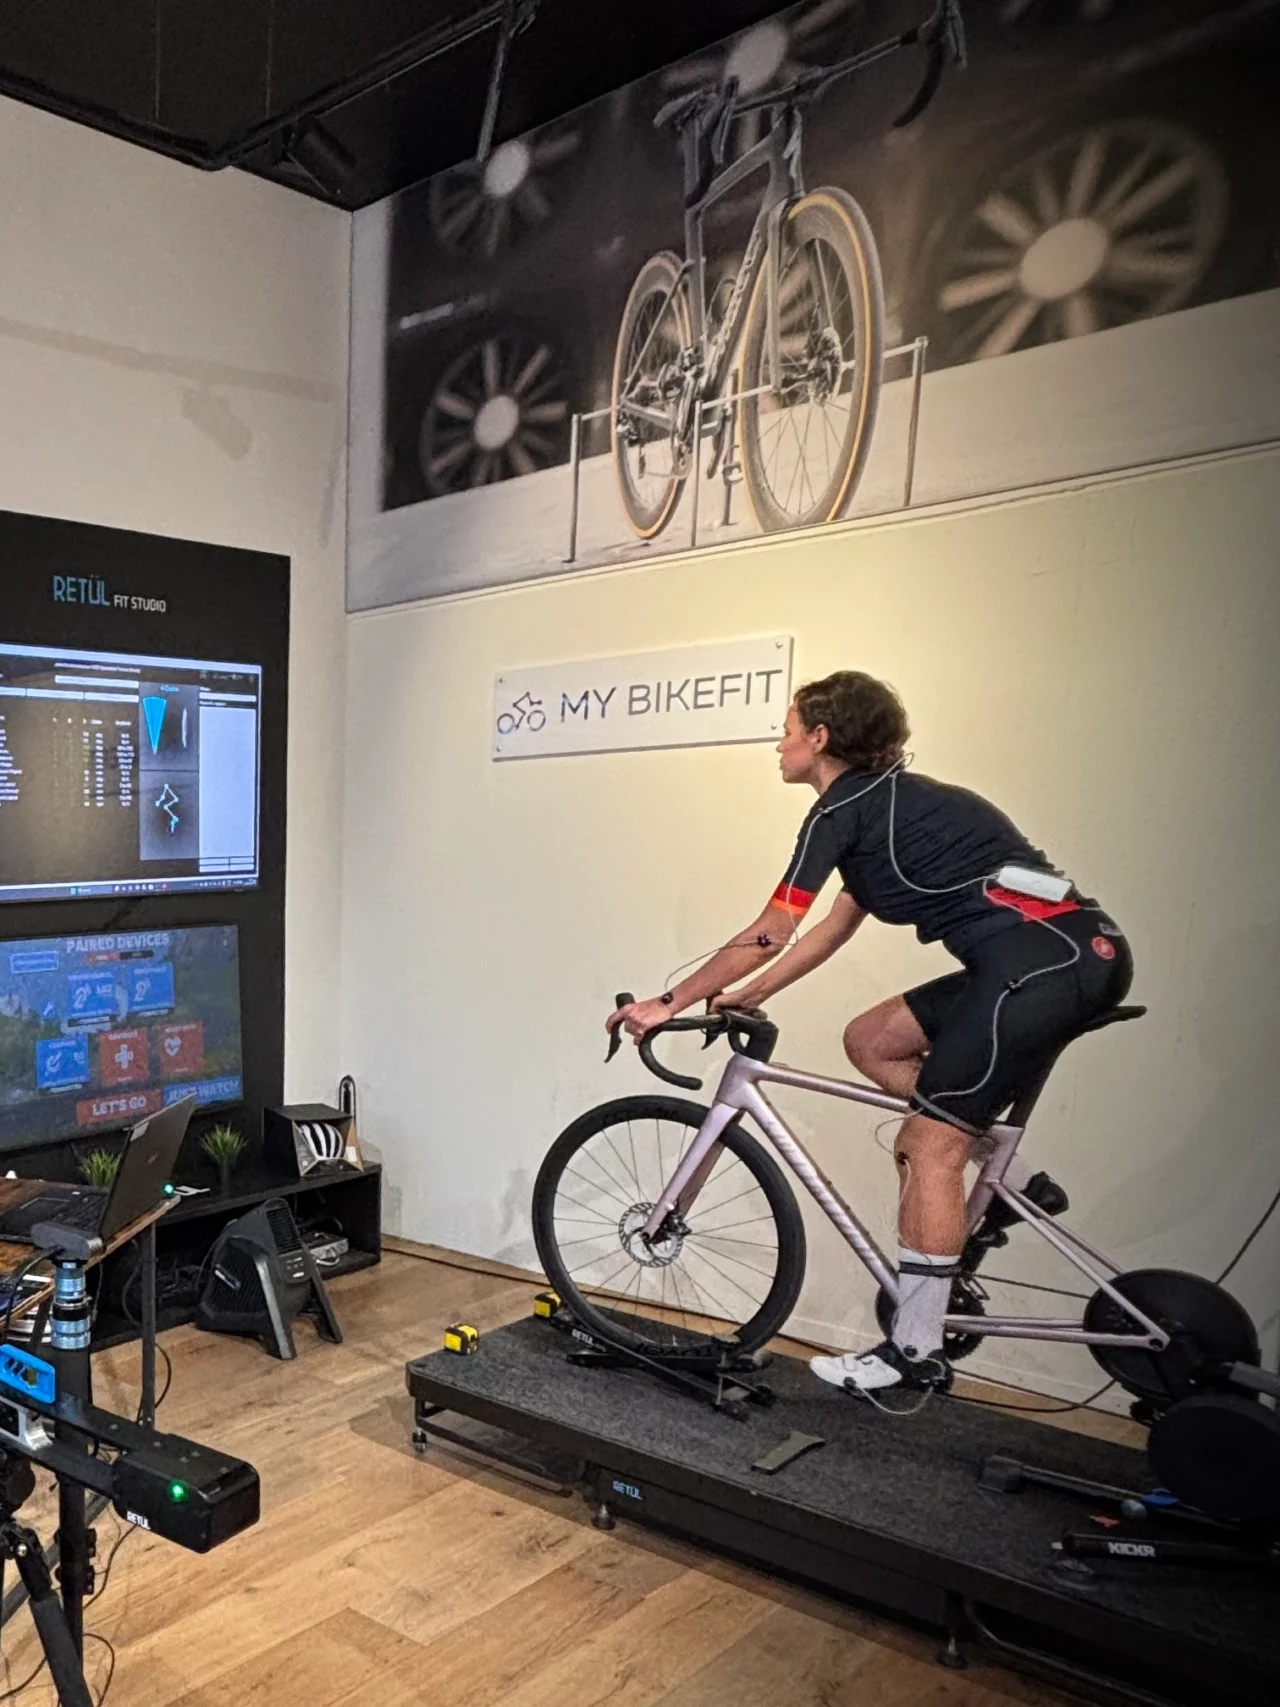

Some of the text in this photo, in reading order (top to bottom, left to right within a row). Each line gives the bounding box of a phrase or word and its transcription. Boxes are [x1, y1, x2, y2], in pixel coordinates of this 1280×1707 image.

[113, 594, 130, 608] FIT
[130, 596, 167, 612] STUDIO
[560, 669, 783, 723] MY BIKEFIT
[66, 932, 170, 953] PAIRED DEVICES
[92, 1095, 148, 1117] LET'S GO
[1108, 1542, 1156, 1557] KICKR
